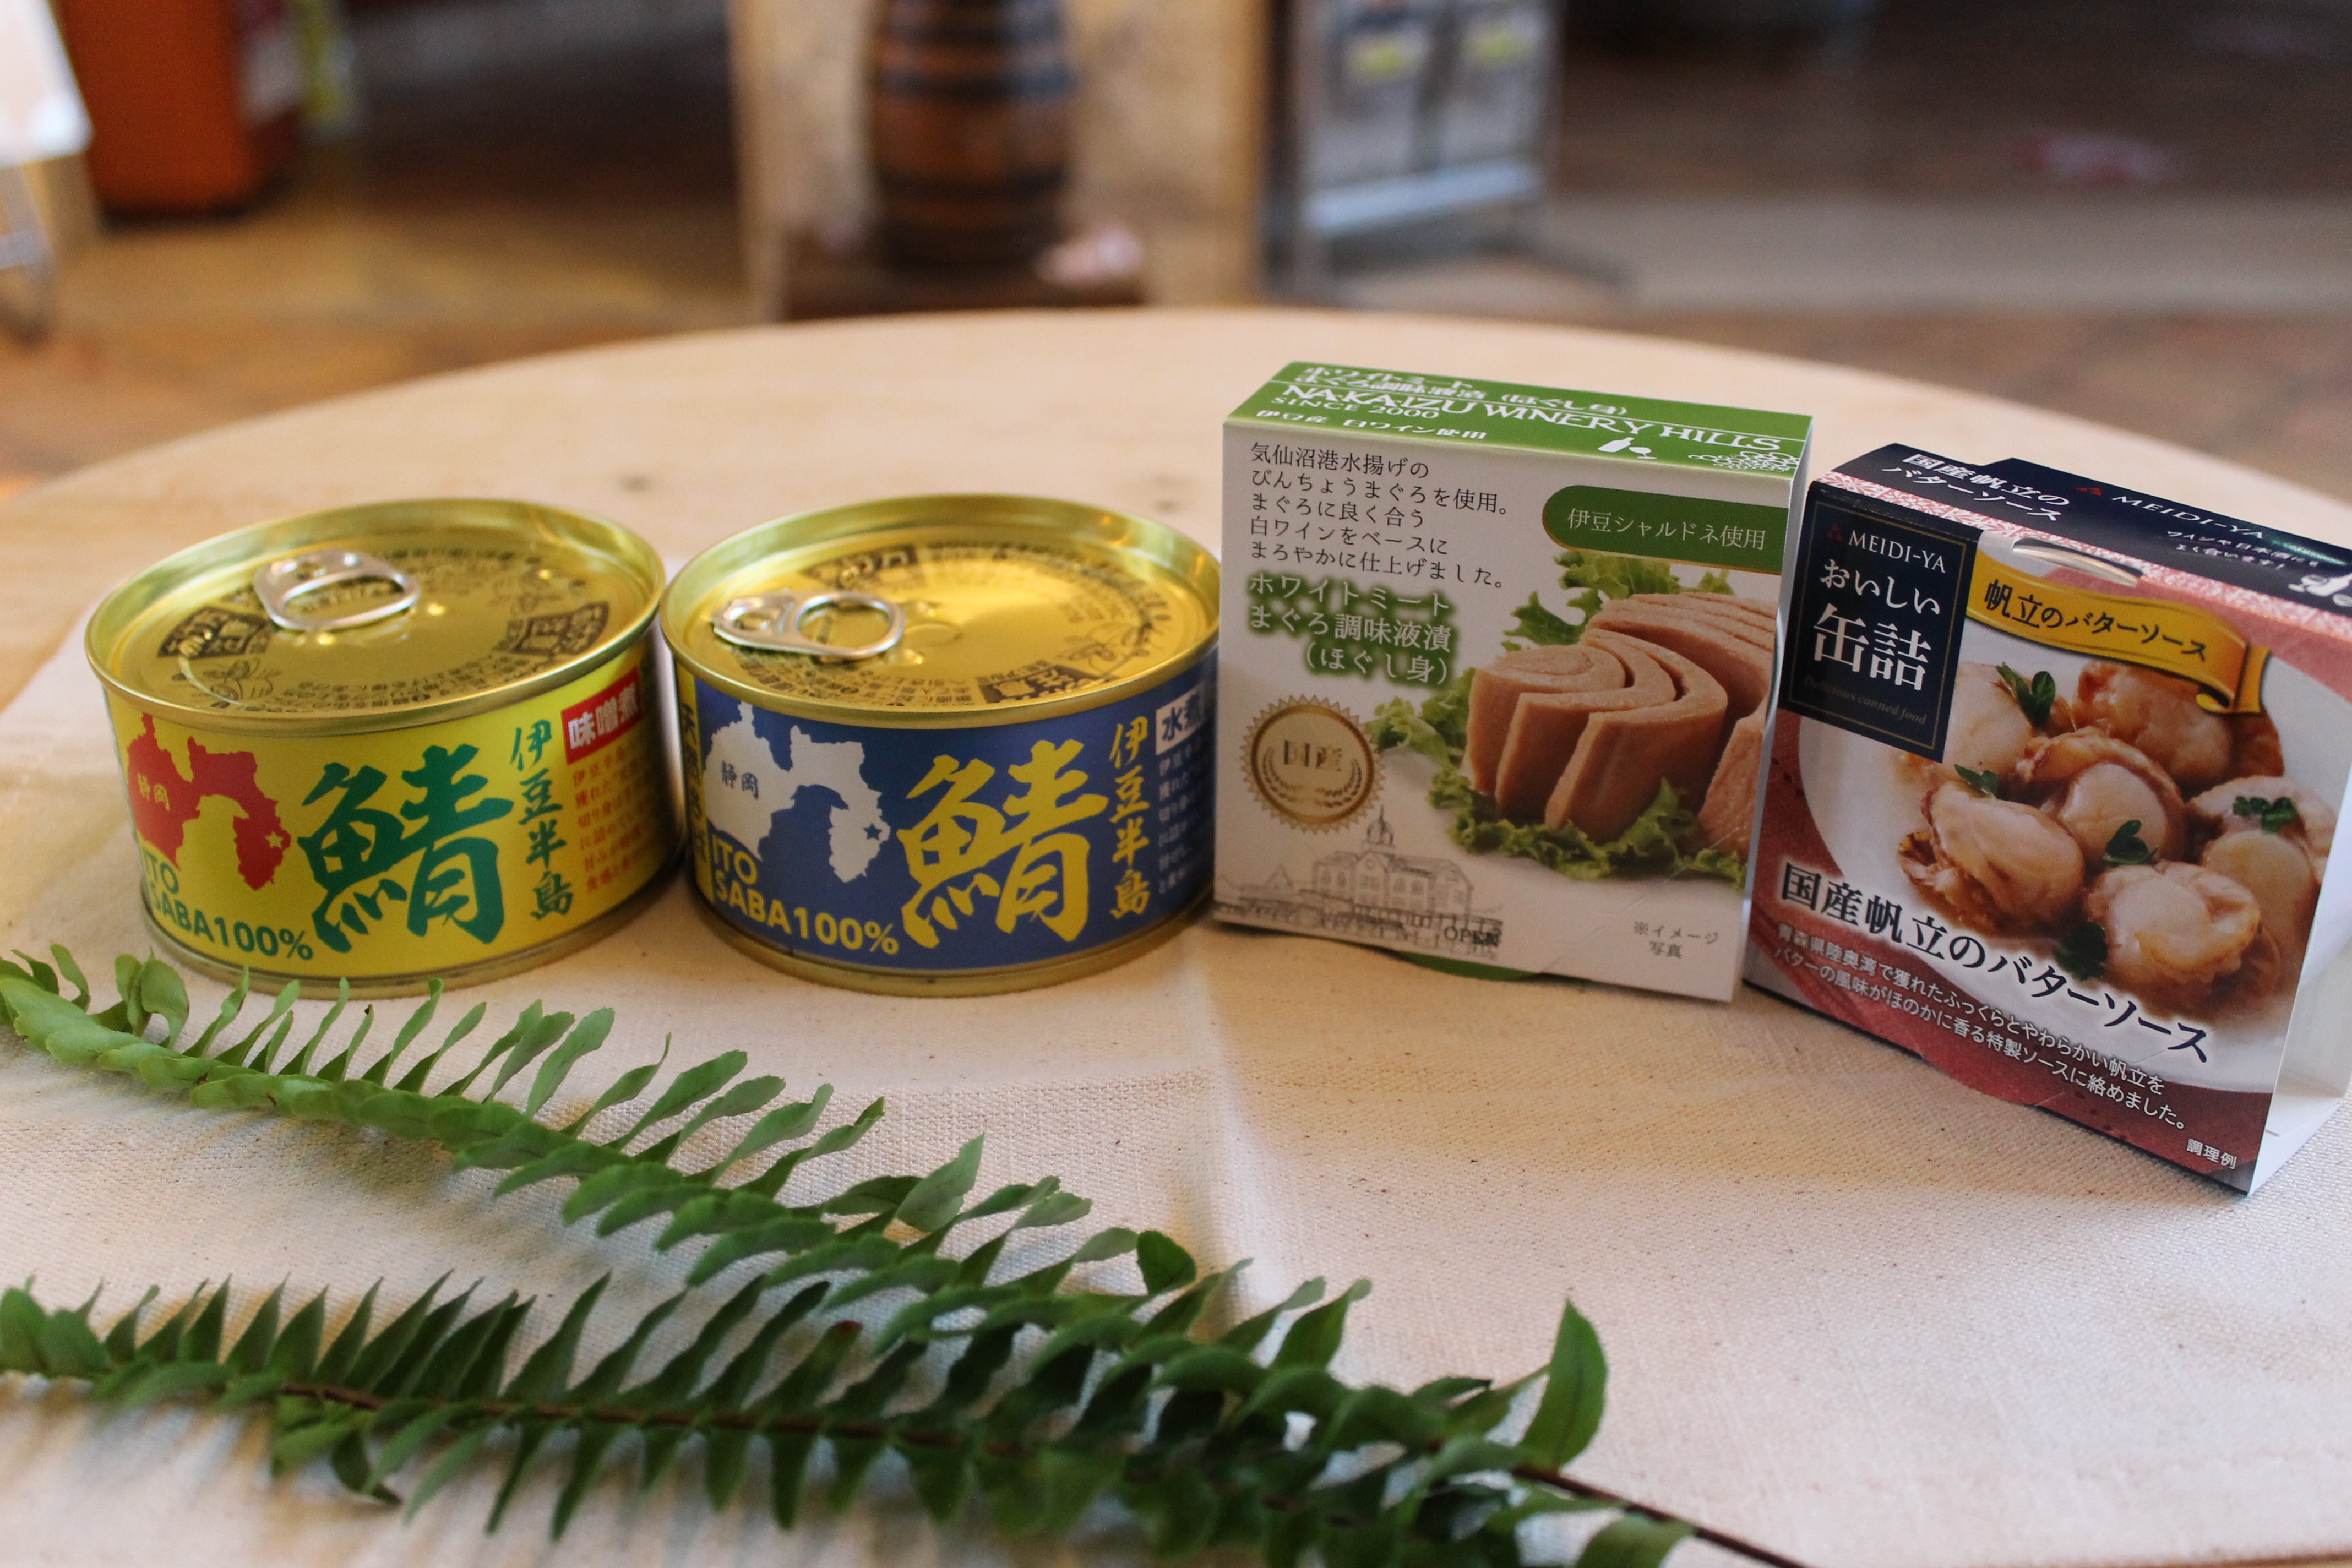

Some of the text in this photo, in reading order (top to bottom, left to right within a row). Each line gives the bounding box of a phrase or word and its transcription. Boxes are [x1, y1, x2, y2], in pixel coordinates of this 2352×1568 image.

[1271, 397, 1440, 419] SINCE 2000
[1484, 404, 1652, 434] WINERY
[1659, 426, 1781, 451] HILLS
[1251, 442, 1429, 478] 気仙沼港水揚げの
[1902, 454, 2070, 505] 国産帆立の
[1253, 469, 1507, 515] びんちょうまぐろを使用。
[1253, 493, 1424, 527] まぐろに良く合う
[1882, 467, 2061, 521] バターソース
[1251, 516, 1448, 555] 白ワインをベースに
[1567, 508, 1766, 550] 伊豆シャルドネ使用
[2111, 495, 2263, 540] MEIDI-YA
[1252, 541, 1502, 589] まろやかに仕上げました。
[1849, 530, 1946, 574] MEIDI-YA
[1249, 574, 1449, 617] ホワイトミート
[1820, 559, 1940, 615] おいしい
[1250, 605, 1452, 654] まぐろ調味液漬
[1984, 579, 2206, 661] 帆立のバターソース
[1814, 603, 1931, 691] 缶詰
[1858, 695, 1900, 716] canned
[1898, 707, 1927, 726] food
[721, 760, 758, 800] 静岡
[510, 720, 573, 920] 伊豆半島
[1108, 715, 1150, 921] 伊豆半島
[297, 743, 513, 953] 鯖
[712, 835, 757, 885] ITO
[896, 739, 1108, 948] 鯖
[1649, 941, 1682, 959] 写真
[1782, 862, 2207, 1063] 国産帆立のバターソース
[1778, 923, 2165, 1096] 青森県陸奥湾で獲れたふっくらとやわらかい帆立を
[1774, 947, 2185, 1130] バターの風味がほのかに香る特製ソースに絡めました。
[2186, 1138, 2238, 1170] 調理例
